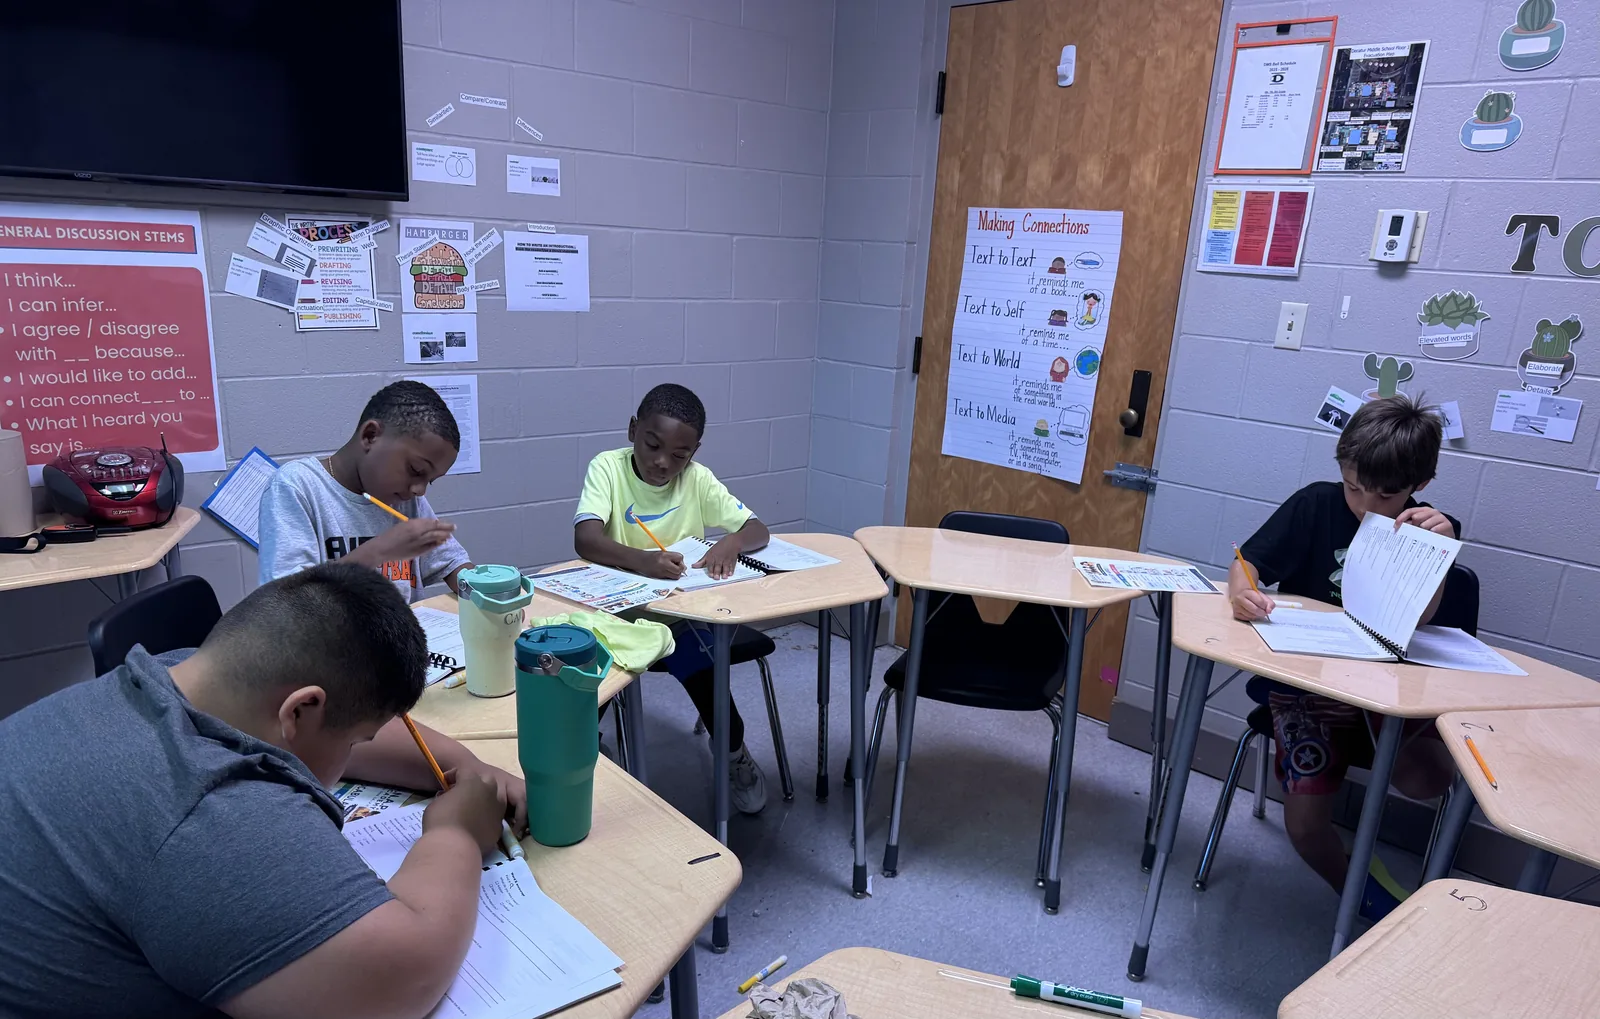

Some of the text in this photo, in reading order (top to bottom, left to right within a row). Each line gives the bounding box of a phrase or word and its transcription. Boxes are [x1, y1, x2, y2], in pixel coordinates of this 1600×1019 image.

[461, 94, 507, 107] Compare/Contrast
[427, 106, 453, 126] Similarities
[517, 119, 542, 140] Differences
[262, 214, 286, 232] Graphic
[286, 229, 314, 249] Organizer
[351, 221, 389, 241] Venn Diagram
[978, 211, 1090, 239] Making Connections
[56, 228, 140, 242] DISCUSSION
[145, 232, 185, 243] STEMS
[406, 228, 468, 240] HAMBURGER
[361, 241, 375, 250] Web
[398, 237, 438, 263] Thesis Statement
[464, 230, 496, 258] Hook the reader
[474, 250, 482, 259] the
[972, 246, 1036, 267] Text to Text
[4, 273, 76, 288] I think...
[457, 281, 499, 294] Body Paragraphs
[1028, 272, 1085, 289] it reminds me
[1030, 286, 1038, 295] of
[8, 298, 117, 312] I can infer...
[355, 297, 393, 310] Capitalization
[416, 294, 464, 309] Conclusion
[964, 296, 1027, 320] Text to Self
[12, 319, 180, 341] I agree / disagree
[1019, 325, 1070, 341] it reminds me
[1021, 338, 1030, 346] of
[1419, 336, 1450, 344] Elevated
[16, 346, 185, 361] with because...
[957, 344, 1021, 369] Text to World
[1528, 363, 1563, 373] Elaborate
[20, 367, 197, 385] I would like to add...
[1012, 374, 1062, 392] it reminds me
[21, 396, 25, 408] I
[31, 397, 64, 408] can
[179, 389, 195, 400] to
[1024, 388, 1054, 402] something
[1526, 386, 1552, 396] Details
[1013, 394, 1022, 403] the
[1024, 396, 1036, 405] real
[954, 399, 1016, 426] Text to Media
[26, 410, 183, 432] What I heard you
[1008, 430, 1055, 449] it reminds me
[30, 440, 64, 457] say
[1019, 443, 1049, 456] something
[1050, 450, 1058, 458] on
[1022, 452, 1032, 461] the
